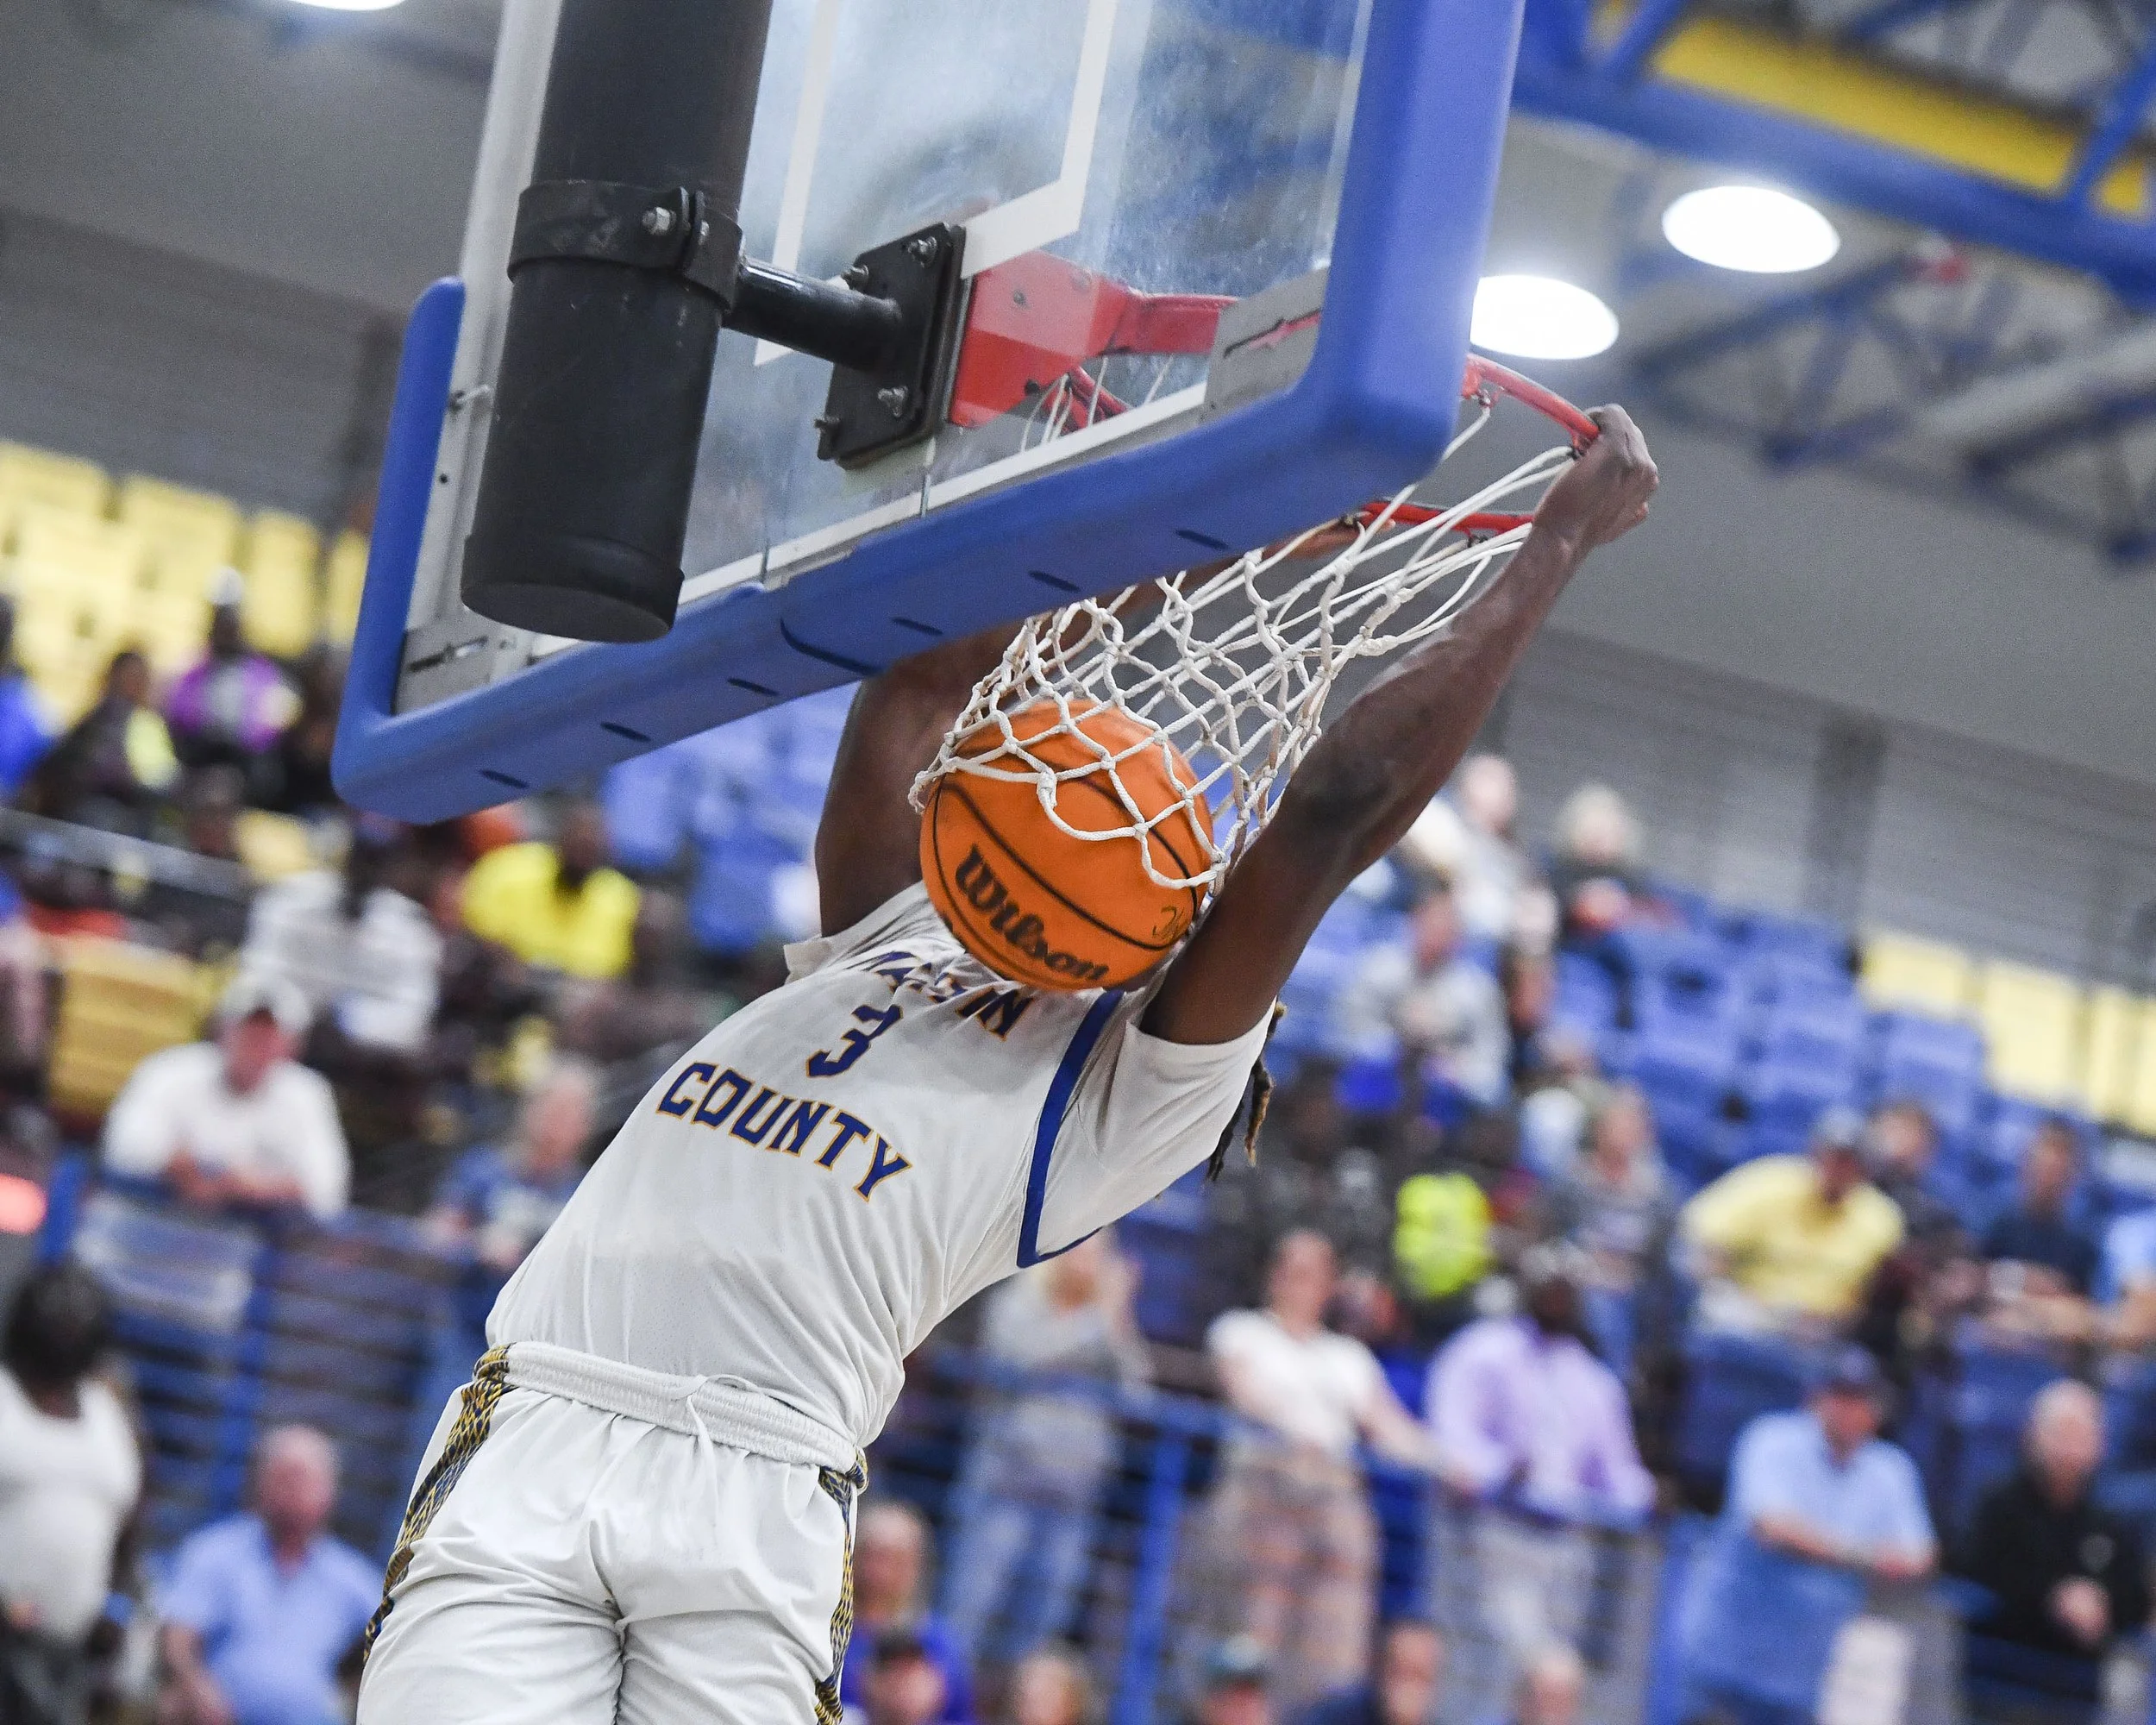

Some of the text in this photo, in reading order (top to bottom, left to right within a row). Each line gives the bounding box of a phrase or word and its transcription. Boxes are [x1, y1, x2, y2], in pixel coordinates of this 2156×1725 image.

[956, 843, 1109, 981] Wilson
[805, 1003, 904, 1079] 3
[656, 1061, 912, 1202] COUNTY
